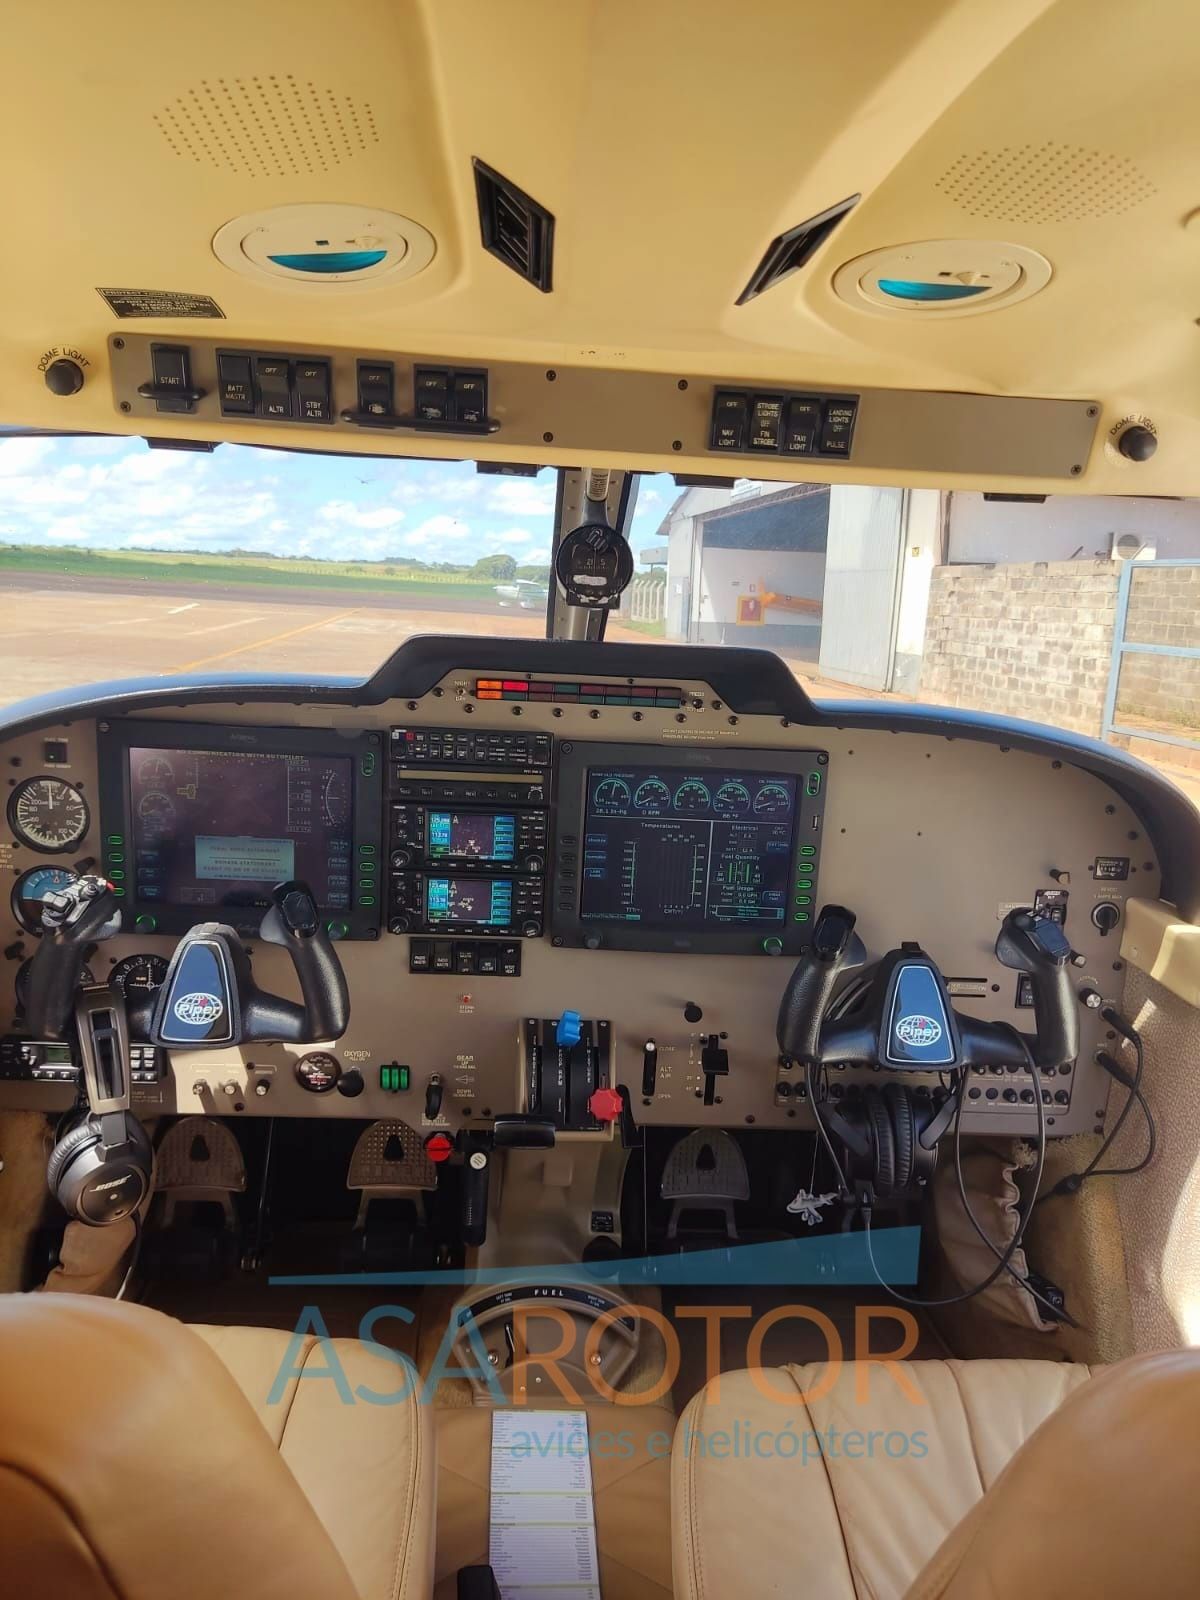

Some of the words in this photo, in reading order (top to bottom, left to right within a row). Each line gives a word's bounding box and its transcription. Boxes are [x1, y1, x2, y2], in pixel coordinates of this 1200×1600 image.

[37, 347, 60, 371] DOME
[63, 347, 91, 368] LIGHT
[160, 377, 179, 385] START
[227, 384, 243, 392] BATT
[268, 405, 284, 413] ALTR
[306, 401, 321, 409] STBY
[829, 409, 852, 417] LANDING
[829, 416, 849, 424] LIGHTS
[1110, 414, 1136, 436] DOME
[1138, 415, 1157, 435] LIGHT
[753, 437, 775, 446] STROBE
[794, 434, 807, 442] TAXI
[826, 441, 845, 449] PULSE
[178, 1004, 220, 1017] Piper
[900, 1026, 940, 1039] Piper
[93, 1175, 130, 1191] BOSE
[534, 1289, 564, 1297] FUEL
